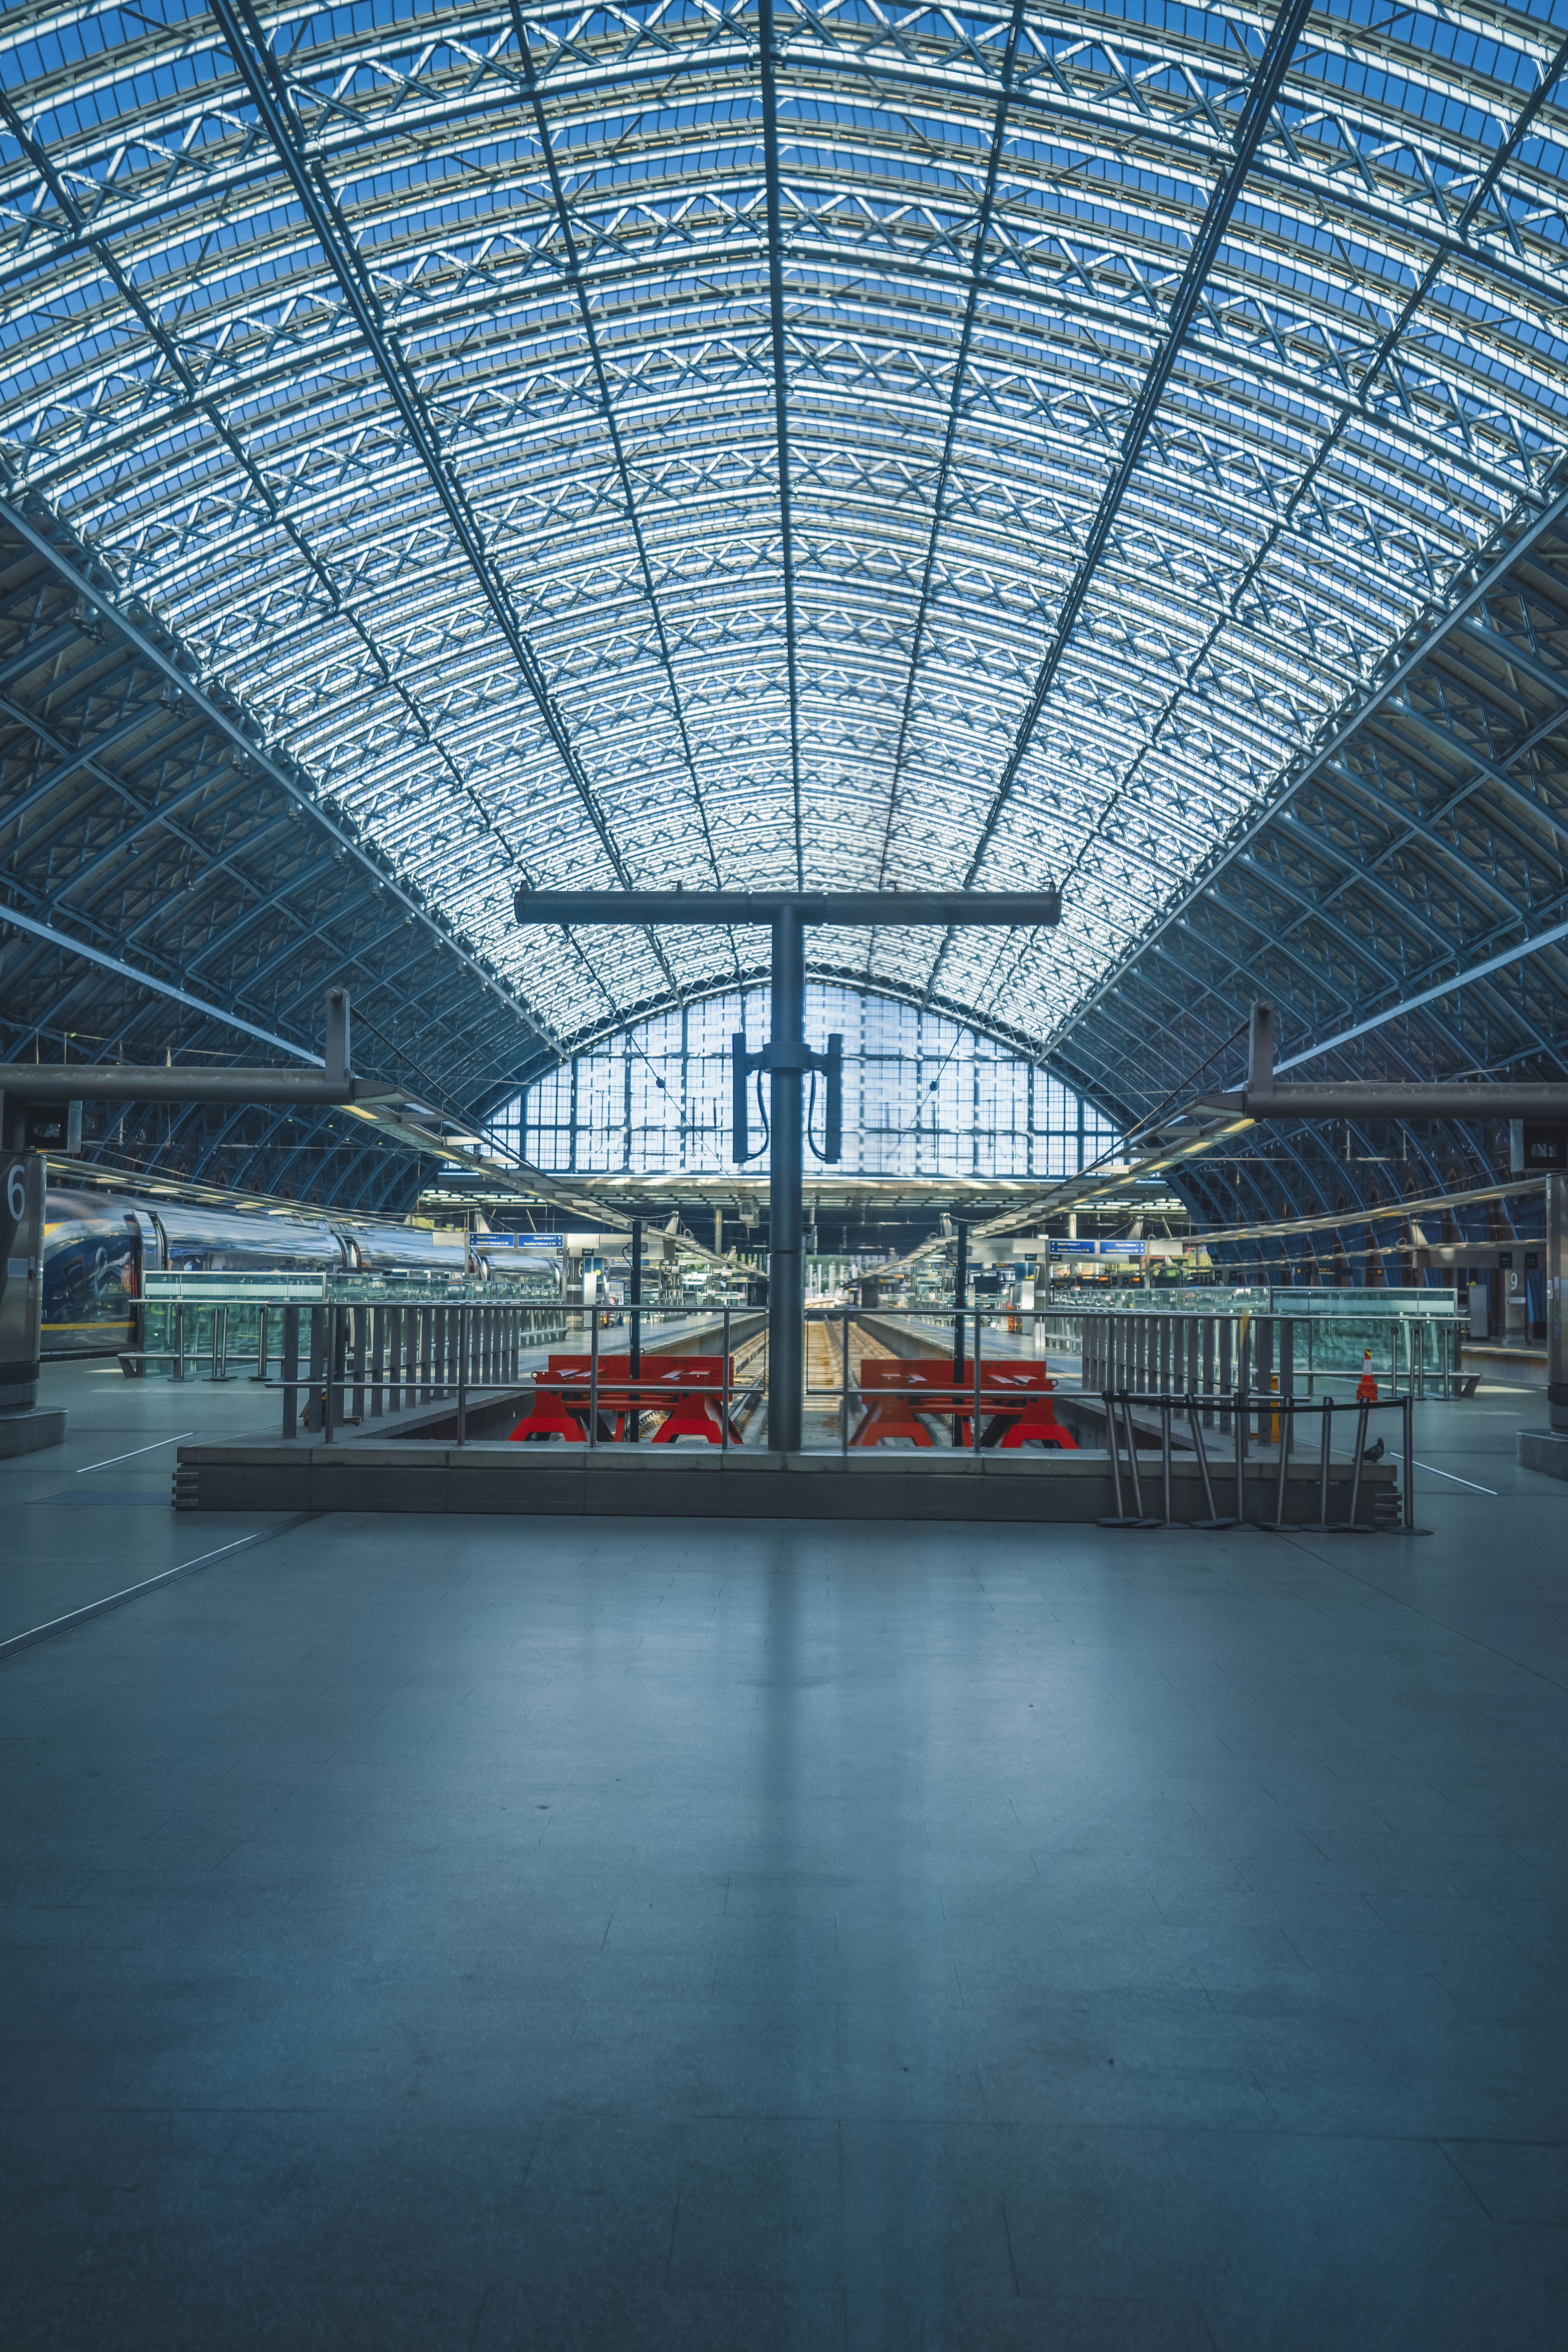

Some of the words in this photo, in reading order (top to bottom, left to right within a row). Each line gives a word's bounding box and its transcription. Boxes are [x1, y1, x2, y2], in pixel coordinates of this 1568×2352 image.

[8, 1165, 25, 1220] 6
[579, 1261, 583, 1278] 6
[1036, 1266, 1040, 1283] 7
[1511, 1272, 1518, 1290] 9
